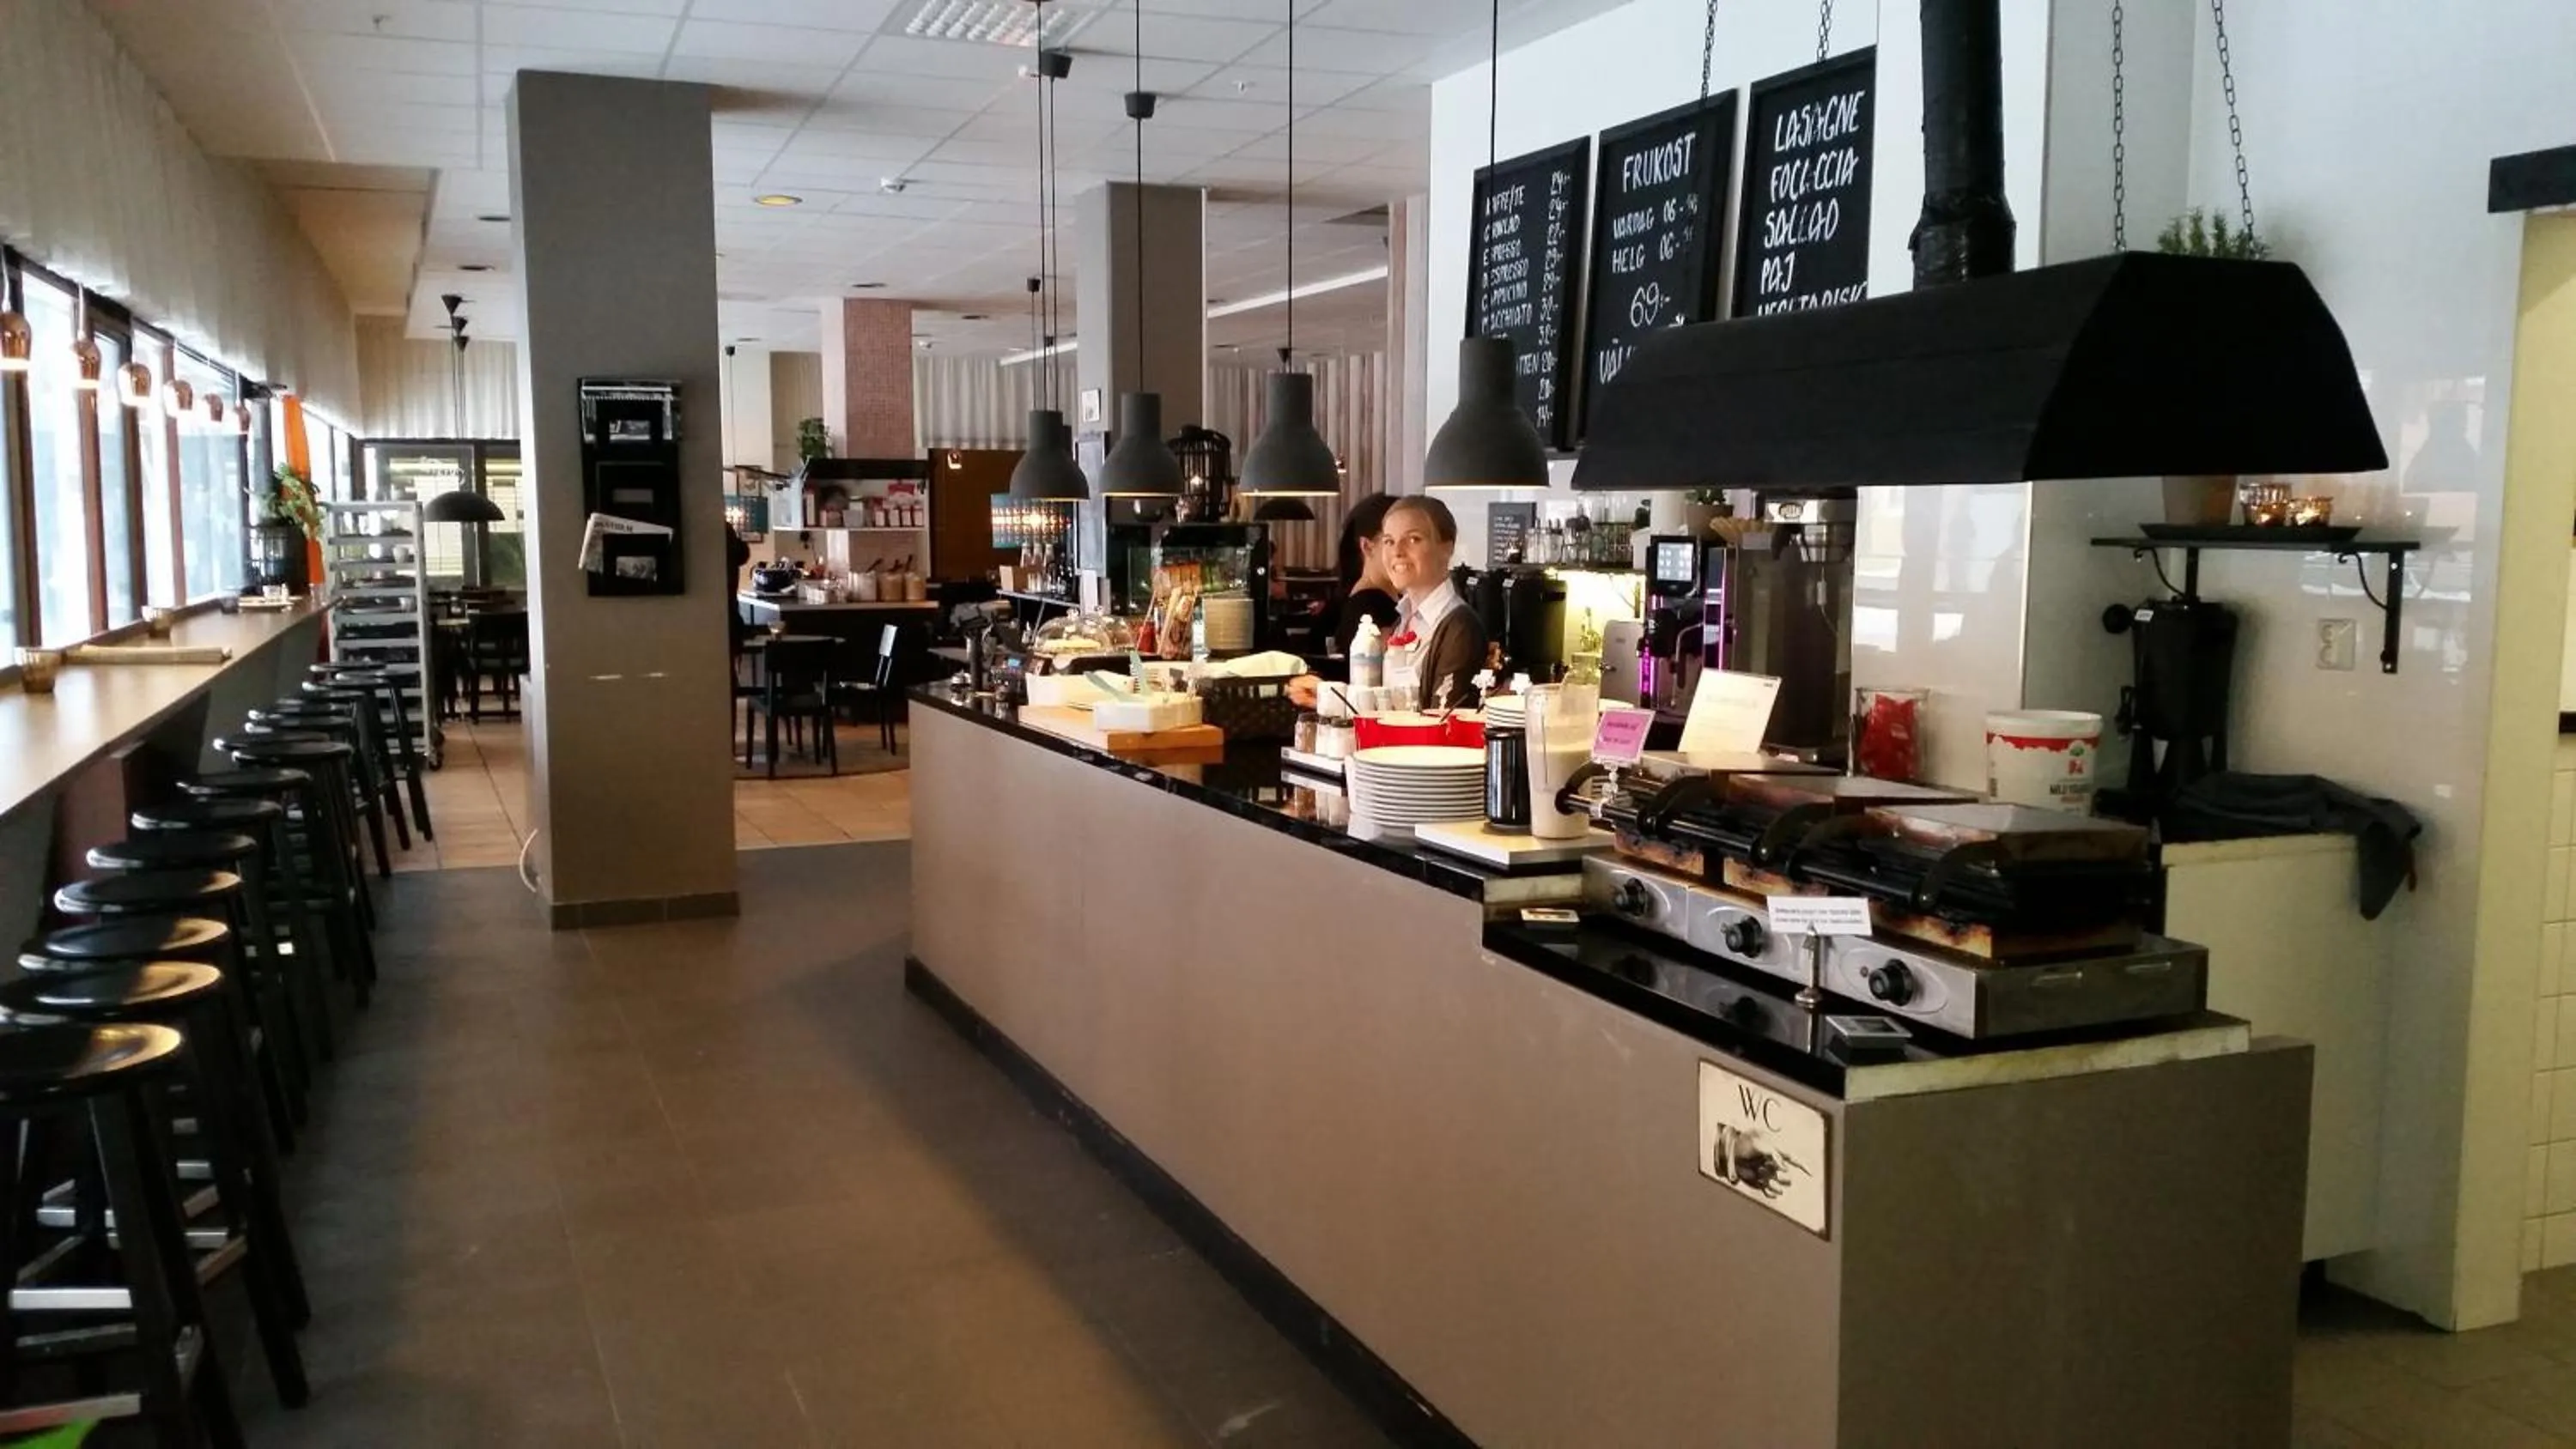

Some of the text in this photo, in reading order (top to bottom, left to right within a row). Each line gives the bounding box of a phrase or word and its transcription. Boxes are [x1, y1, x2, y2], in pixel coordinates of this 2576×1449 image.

[1775, 90, 1866, 152] LASAGNE
[1623, 131, 1696, 193] FRUKOST
[1613, 207, 1655, 239] VARDAG
[1764, 197, 1839, 248] SALLAD
[1612, 243, 1645, 274] HELG
[1760, 251, 1795, 294] PAJ
[1738, 1084, 1782, 1133] WC
